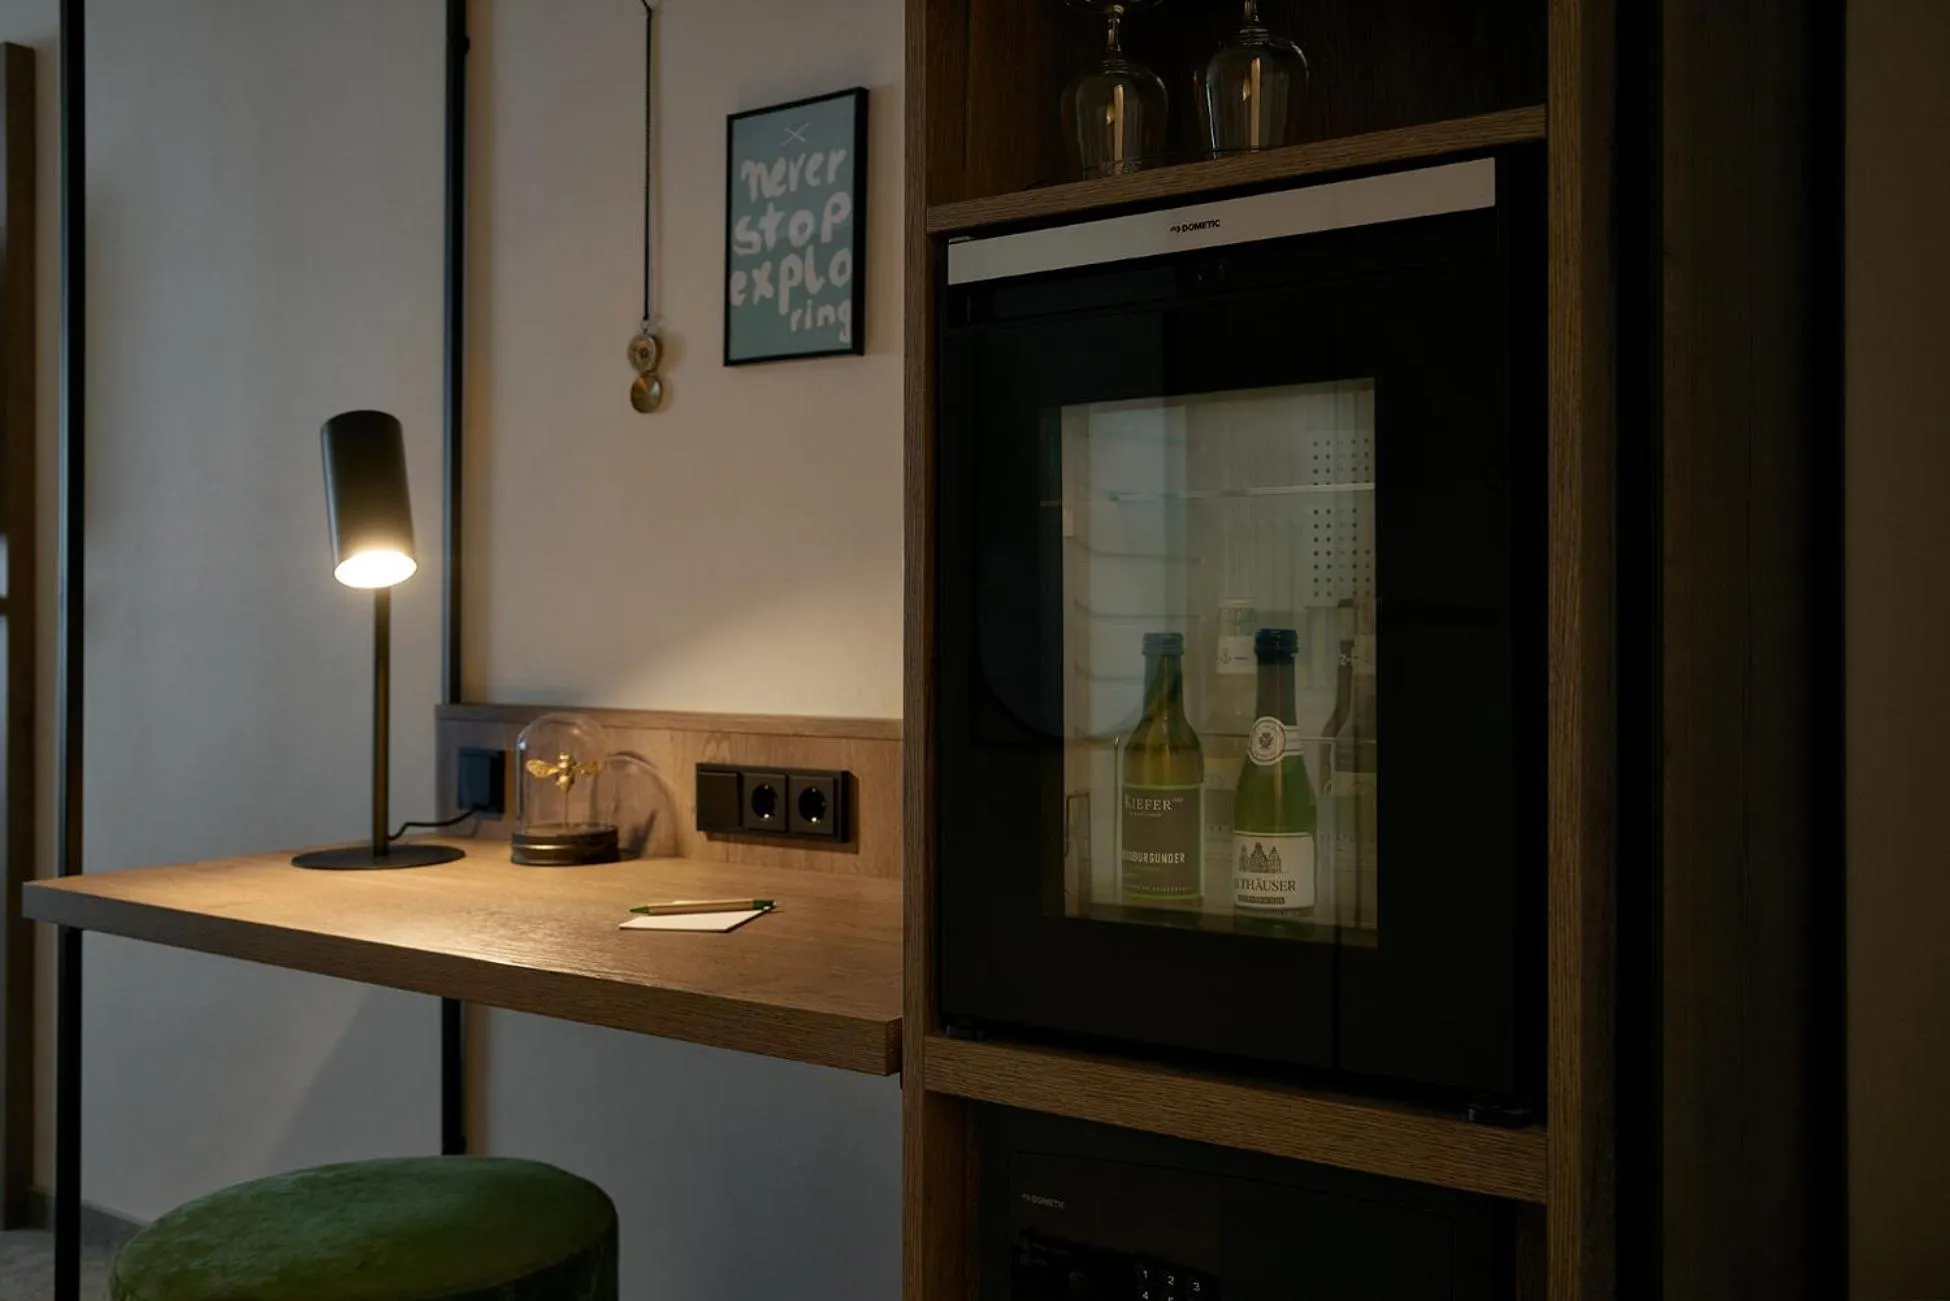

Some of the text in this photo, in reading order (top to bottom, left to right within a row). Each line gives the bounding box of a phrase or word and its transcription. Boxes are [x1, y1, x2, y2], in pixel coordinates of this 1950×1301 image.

[741, 148, 847, 202] never
[734, 193, 851, 255] stop
[1182, 219, 1220, 232] DOMETIC
[730, 245, 852, 315] explo
[790, 299, 852, 343] ring
[1125, 795, 1171, 811] KIEFER
[1167, 1274, 1175, 1286] 2
[1191, 1281, 1201, 1293] 3
